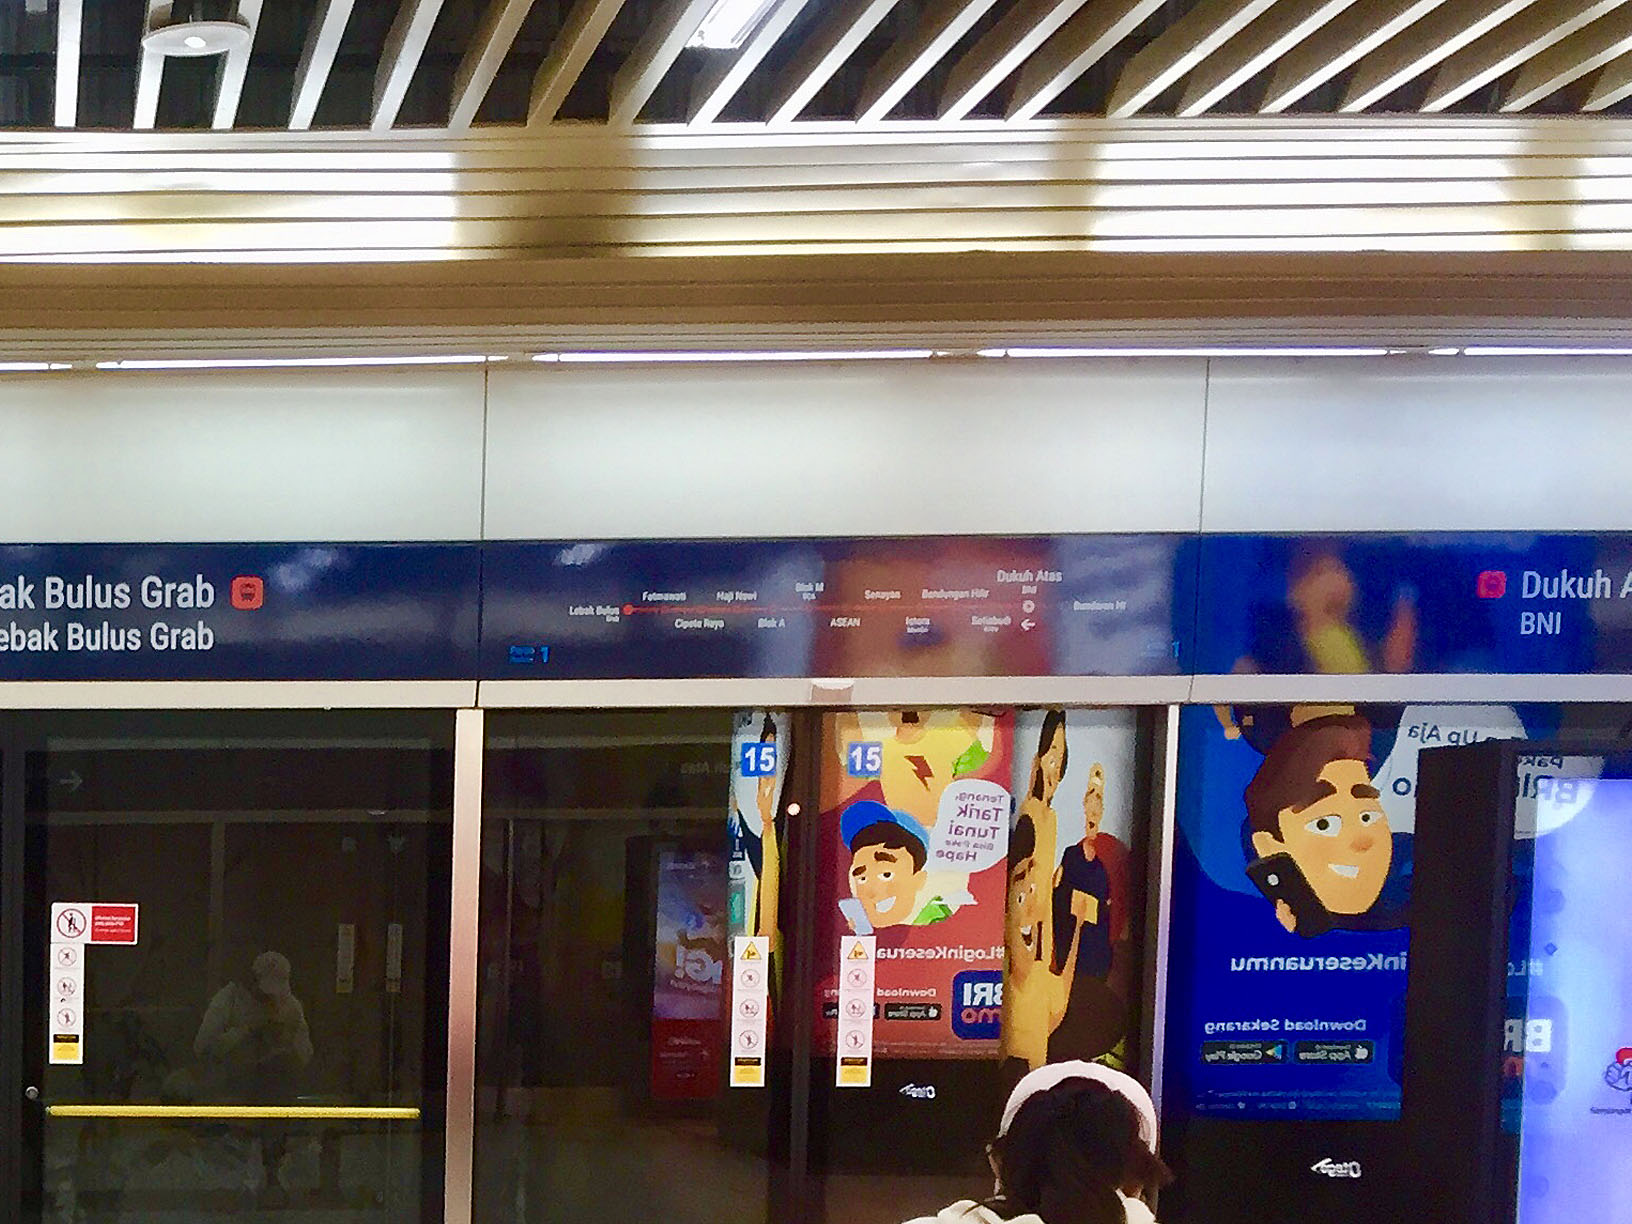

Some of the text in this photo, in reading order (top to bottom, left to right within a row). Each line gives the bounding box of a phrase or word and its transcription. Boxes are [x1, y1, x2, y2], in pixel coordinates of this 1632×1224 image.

[997, 570, 1063, 583] Dukuh Atas
[1522, 569, 1611, 599] Dukuh
[46, 575, 130, 610] Bulus
[140, 575, 214, 609] Grab
[66, 622, 142, 652] Bulus
[151, 622, 214, 651] Grab
[1520, 612, 1561, 635] BNI
[744, 745, 775, 772] 15
[850, 745, 882, 771] 15
